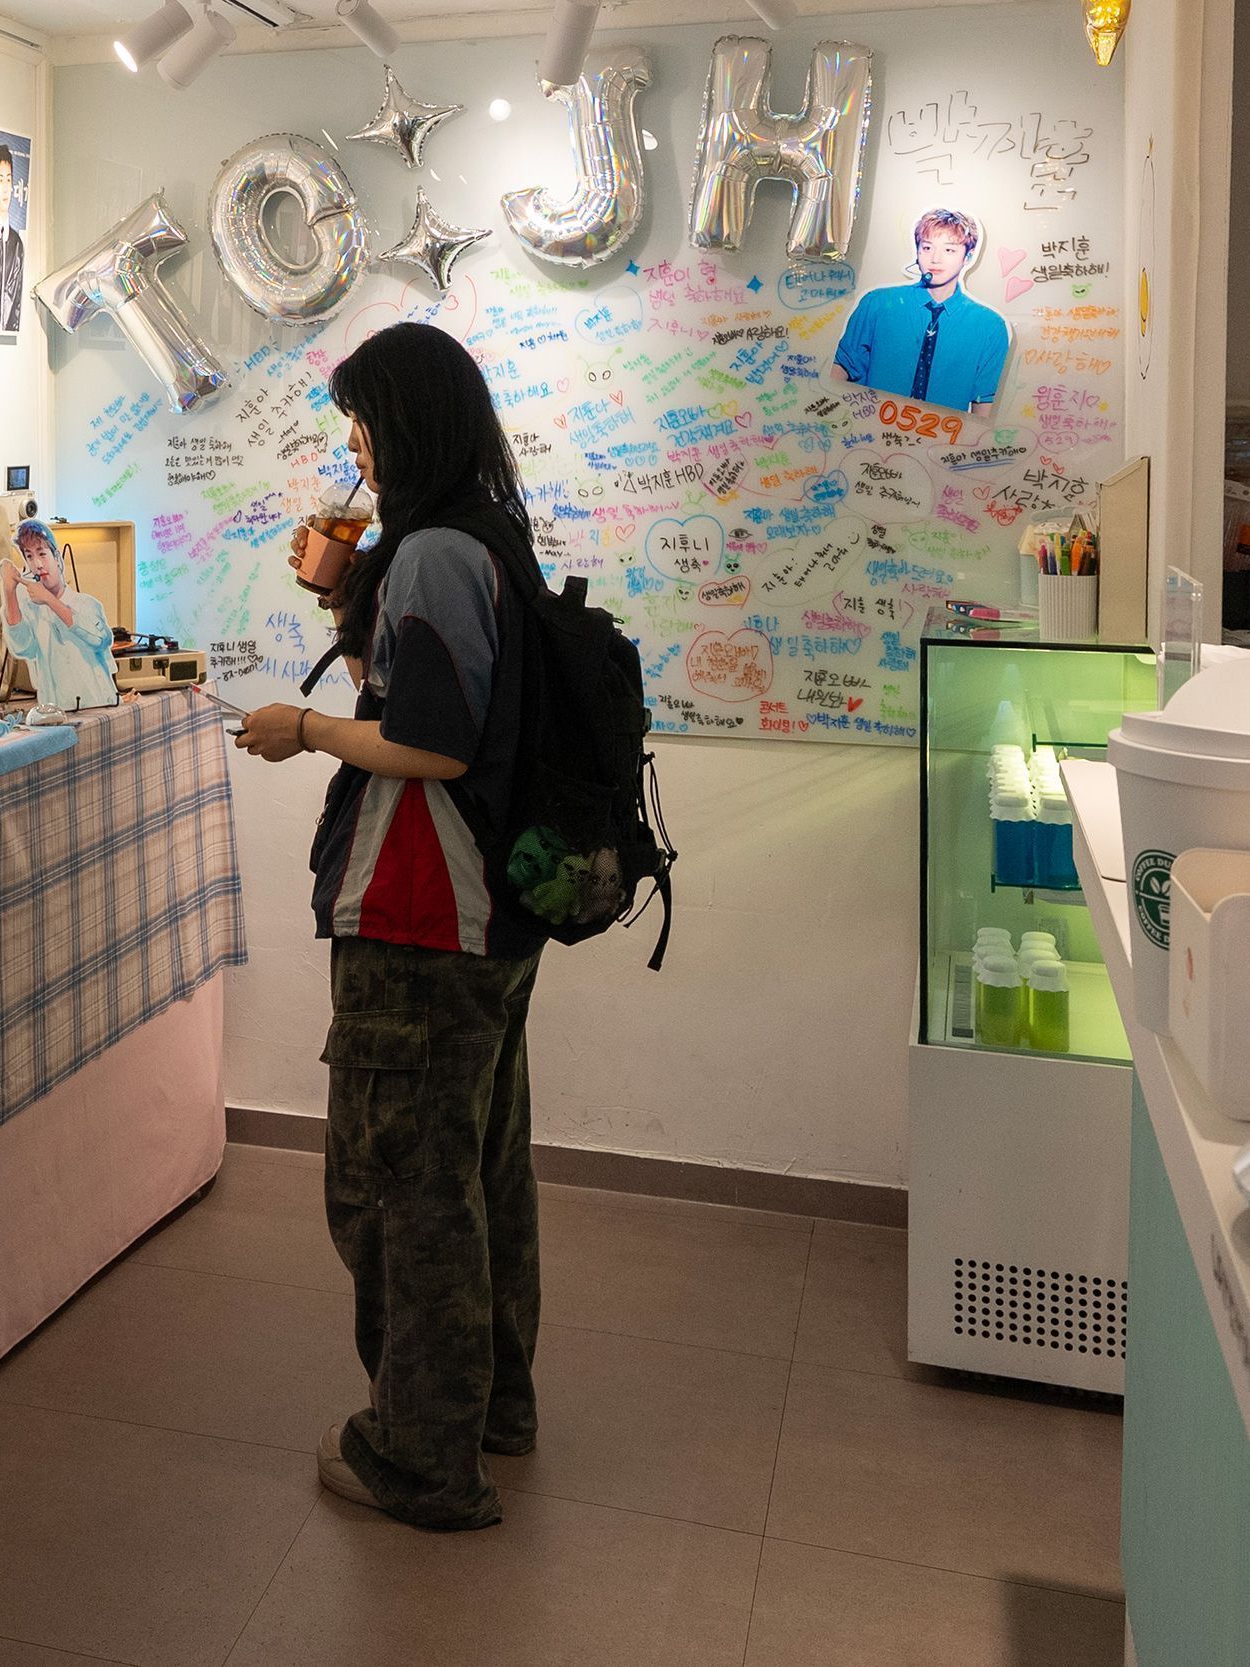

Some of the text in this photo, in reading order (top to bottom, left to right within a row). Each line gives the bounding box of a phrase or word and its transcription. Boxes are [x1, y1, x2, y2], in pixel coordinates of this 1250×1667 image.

[1042, 235, 1090, 261] 박지훈
[698, 259, 717, 285] 형
[1030, 262, 1110, 284] 생일축하해!
[243, 345, 271, 371] HBD
[236, 388, 270, 423] 지훈아
[567, 398, 611, 423] 지훈아
[852, 404, 877, 420] HBD
[247, 418, 275, 447] 생일
[879, 400, 963, 445] 0529
[191, 437, 207, 450] 생일
[638, 463, 704, 495] 박지훈 HBD
[660, 533, 710, 552] 지후니
[673, 558, 703, 575] 생축
[265, 611, 307, 654] 생축
[238, 640, 256, 655] 생일
[803, 669, 872, 688] 지훈오빠
[759, 700, 789, 714] 콘서트
[817, 712, 851, 730] 박지훈
